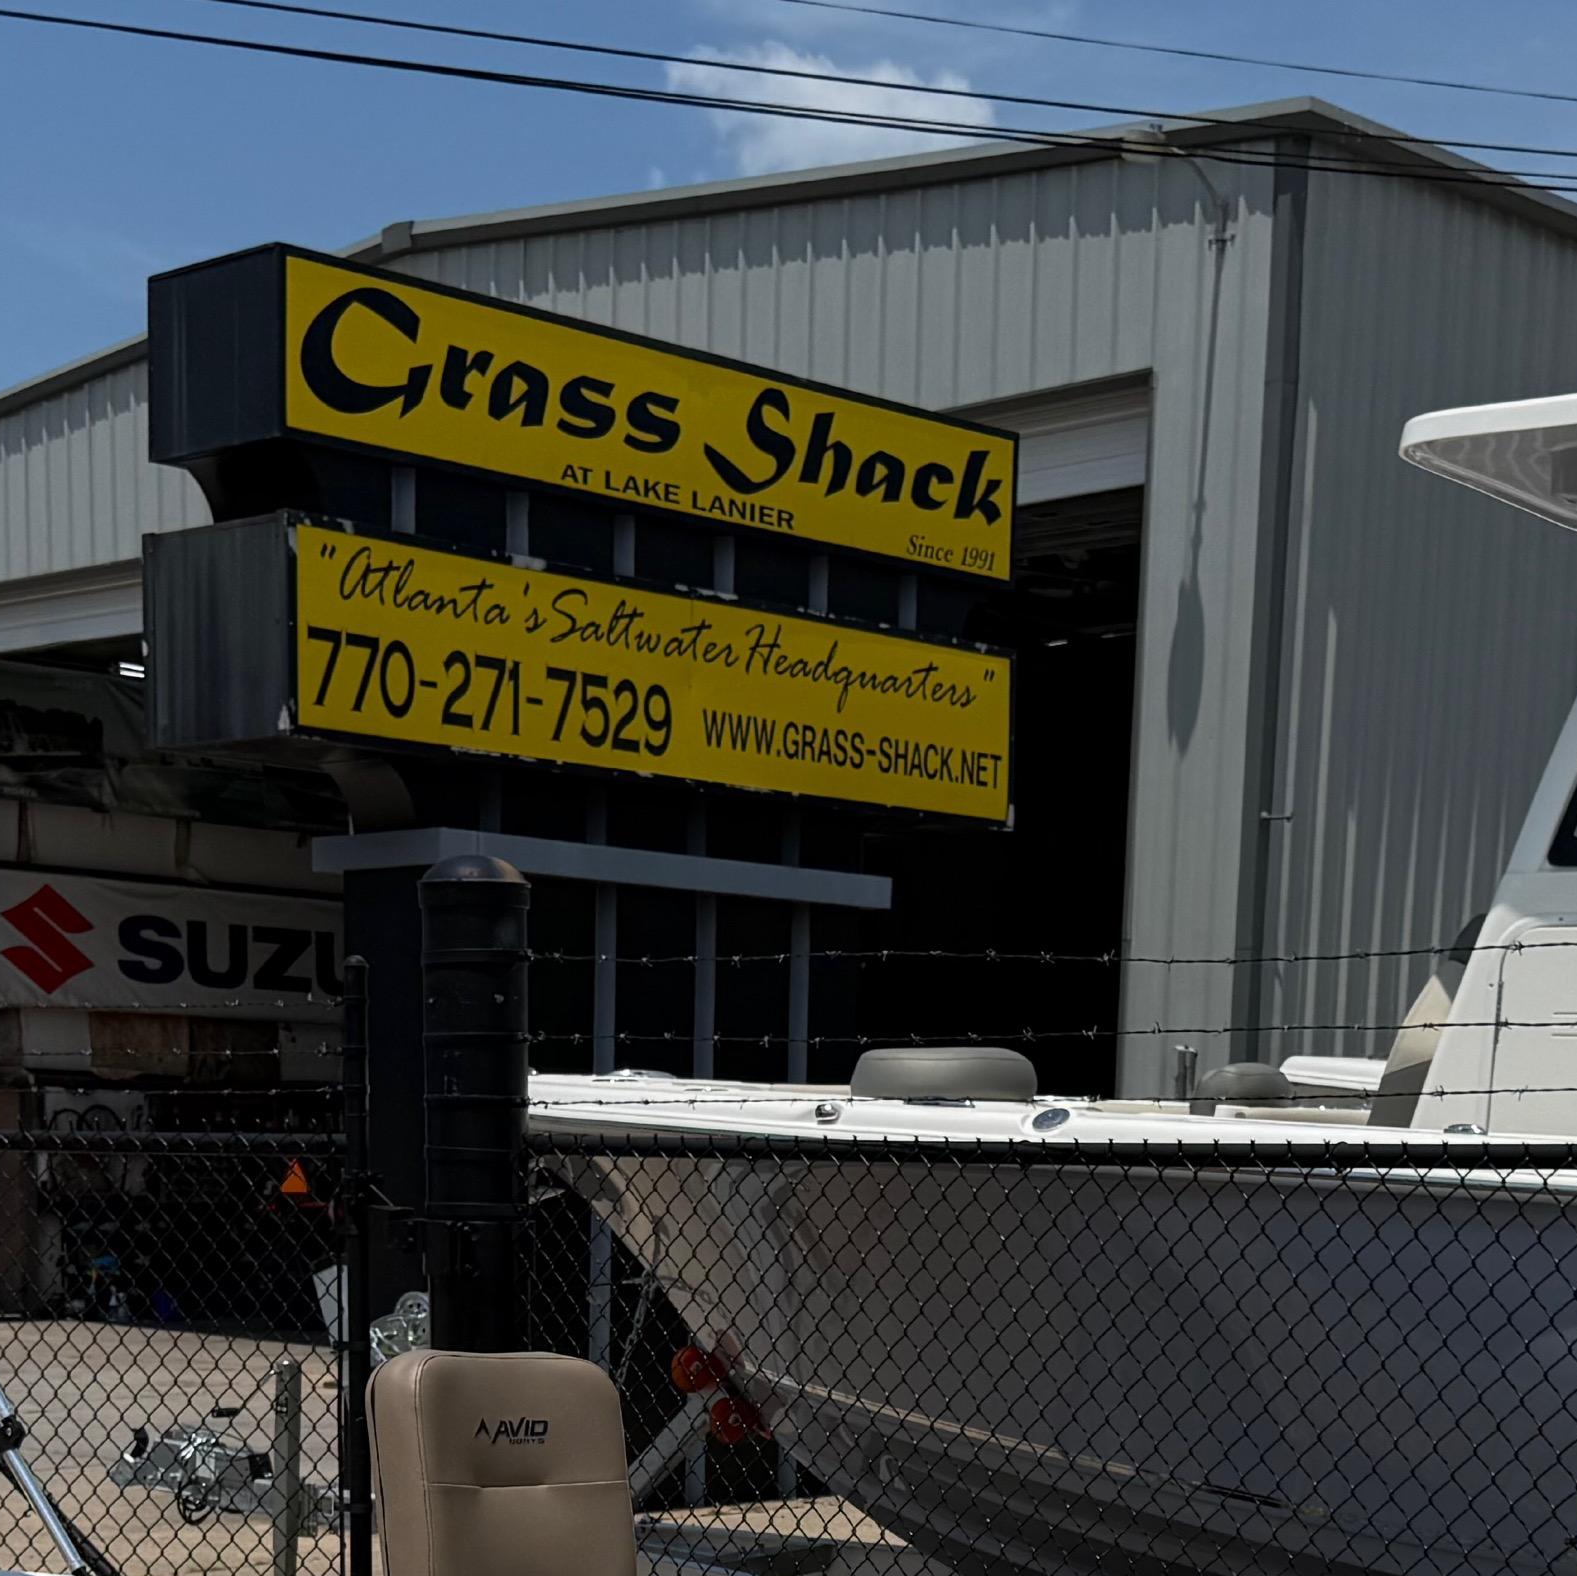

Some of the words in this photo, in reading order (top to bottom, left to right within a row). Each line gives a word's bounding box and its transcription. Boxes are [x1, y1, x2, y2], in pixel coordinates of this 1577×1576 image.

[300, 286, 682, 453] Grass
[703, 387, 1003, 527] Shack
[561, 464, 593, 486] AT
[604, 470, 681, 504] LAKE
[691, 490, 795, 530] LANIER
[906, 534, 954, 564] Since
[961, 546, 995, 572] 1991
[549, 588, 740, 669] Saltwater
[744, 623, 996, 714] Headquarters"
[307, 621, 673, 758] 770-271-7529
[703, 708, 1003, 790] WWW.GRASS-SHACK.NET
[491, 1416, 549, 1444] AVID
